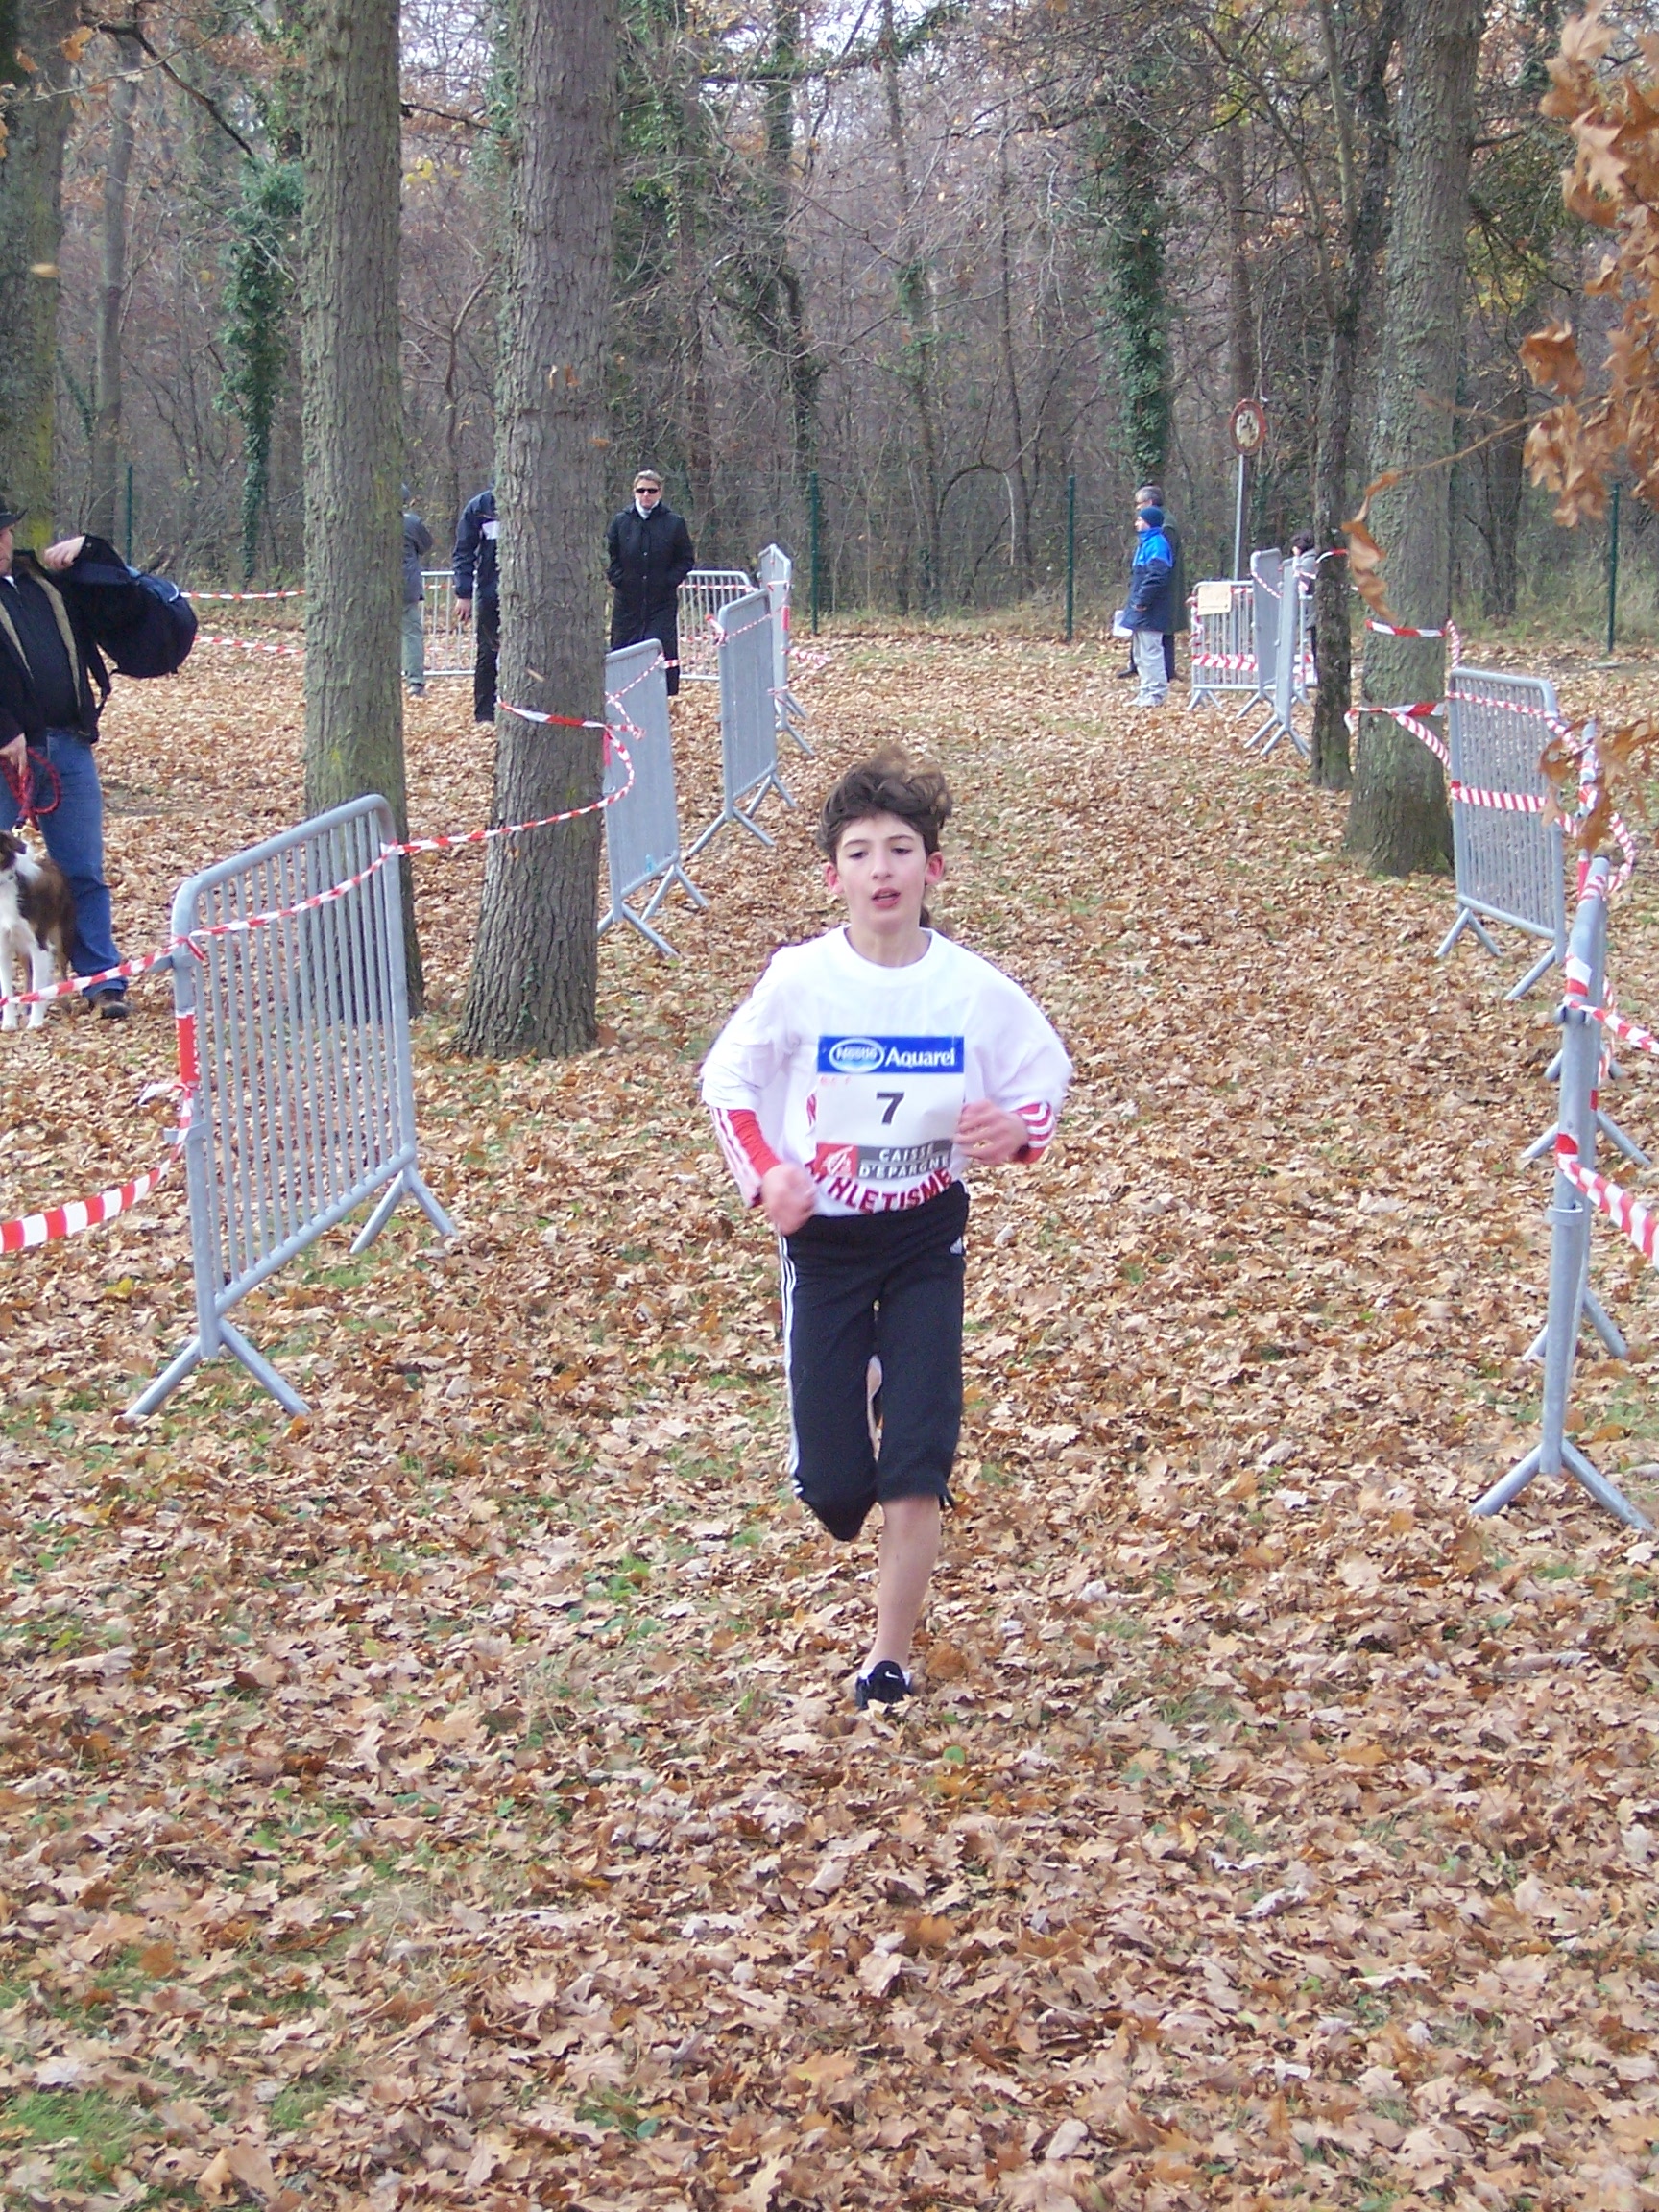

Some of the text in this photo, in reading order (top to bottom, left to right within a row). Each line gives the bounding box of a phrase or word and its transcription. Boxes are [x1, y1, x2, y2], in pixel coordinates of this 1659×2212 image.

[884, 1046, 956, 1067] Aquarel
[876, 1092, 904, 1124] 7
[878, 1142, 935, 1162] CAISSE
